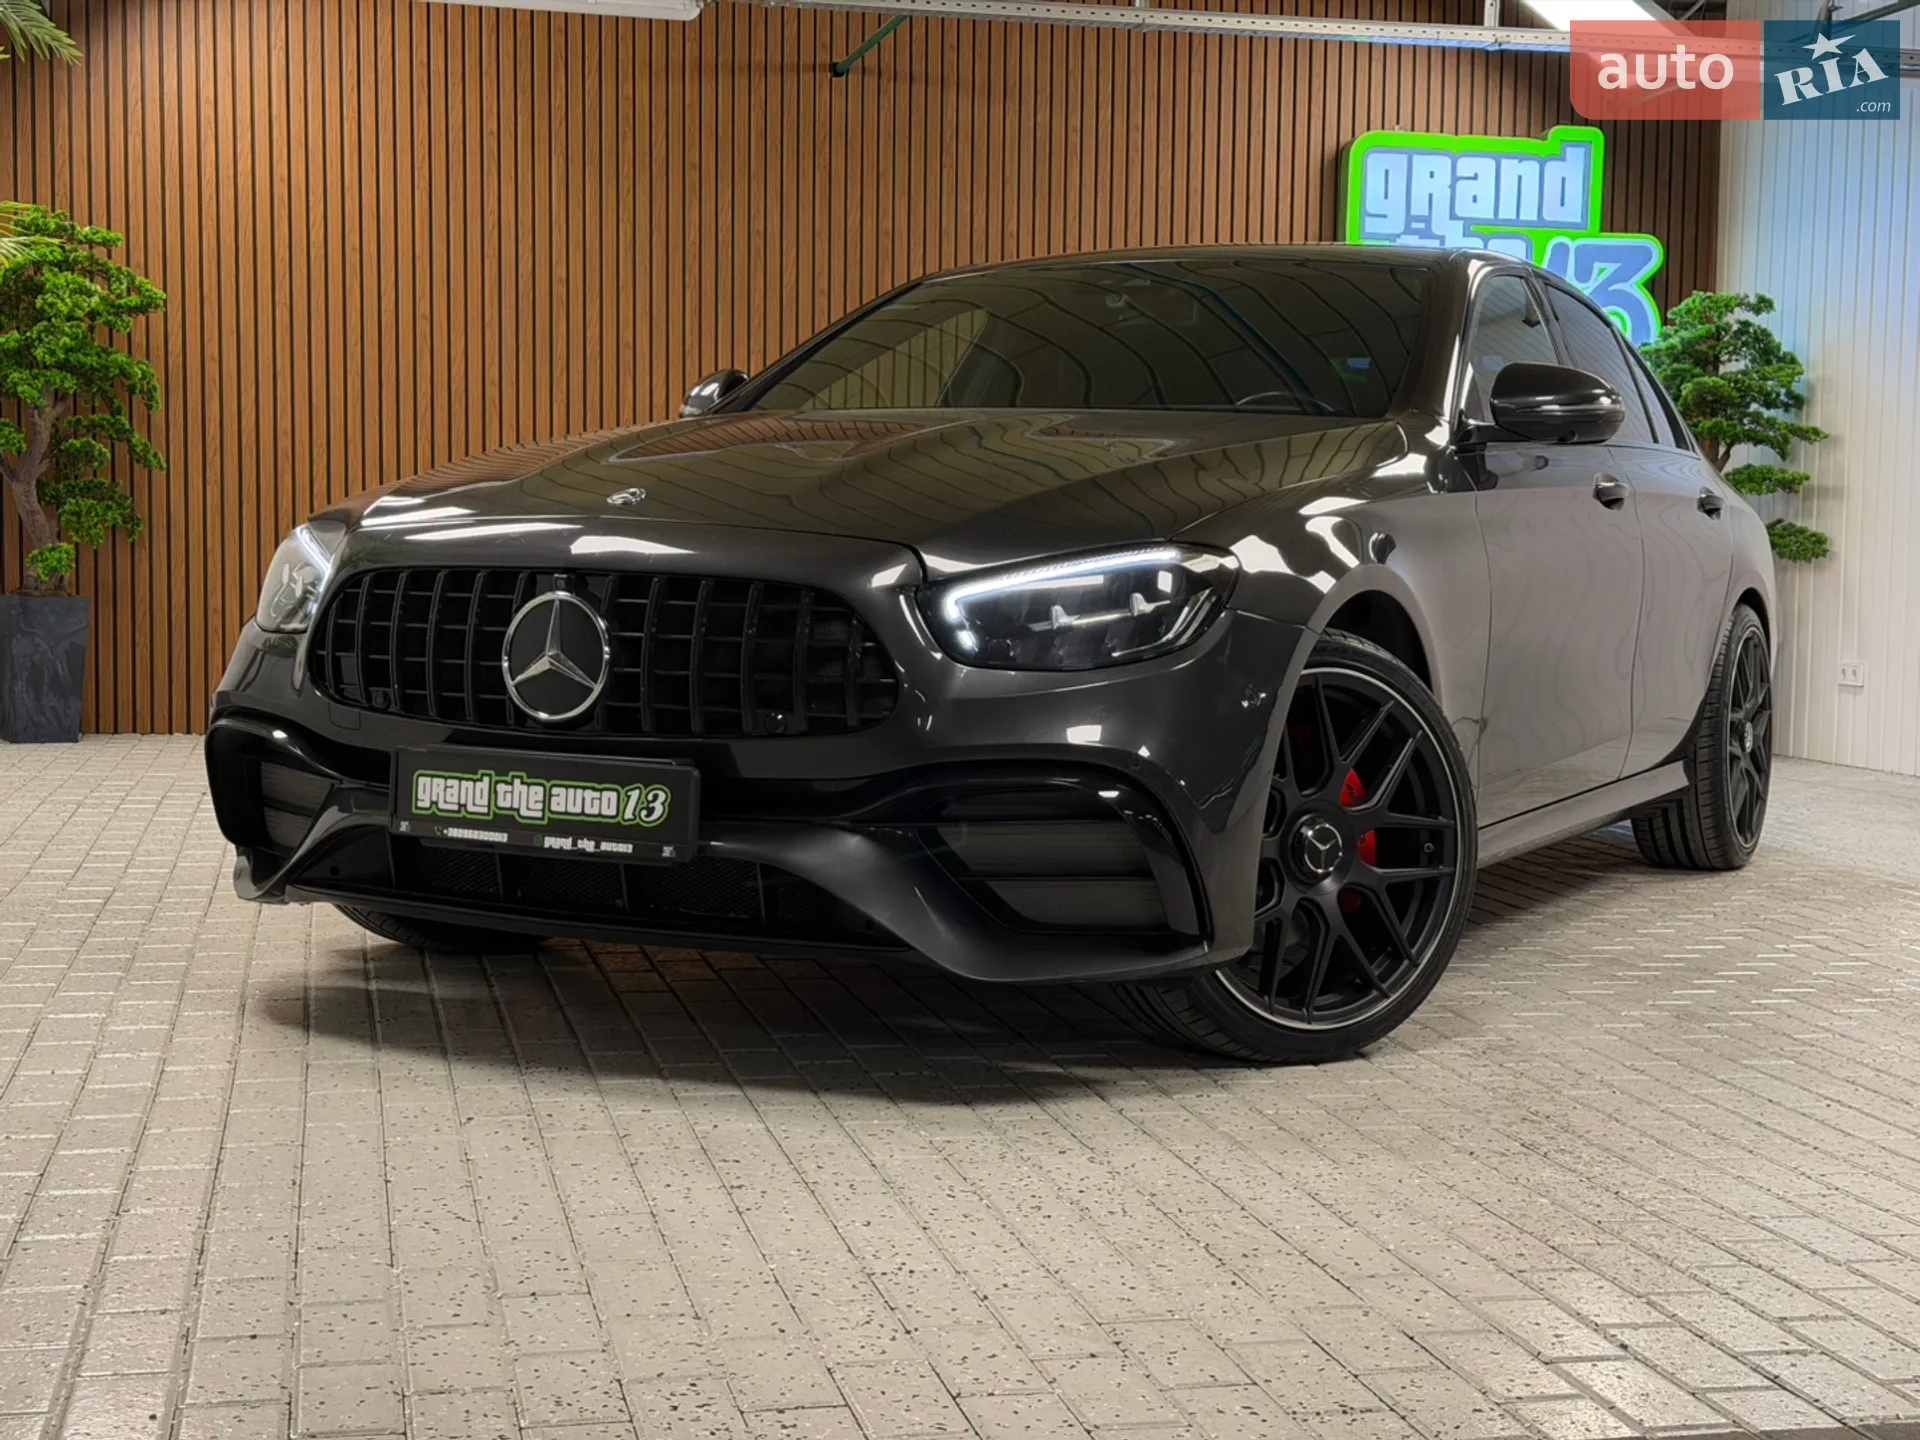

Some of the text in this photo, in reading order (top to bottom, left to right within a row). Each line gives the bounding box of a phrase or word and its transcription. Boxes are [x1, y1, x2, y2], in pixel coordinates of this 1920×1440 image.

[496, 777, 544, 818] the
[551, 786, 618, 817] auto
[624, 788, 669, 822] 13
